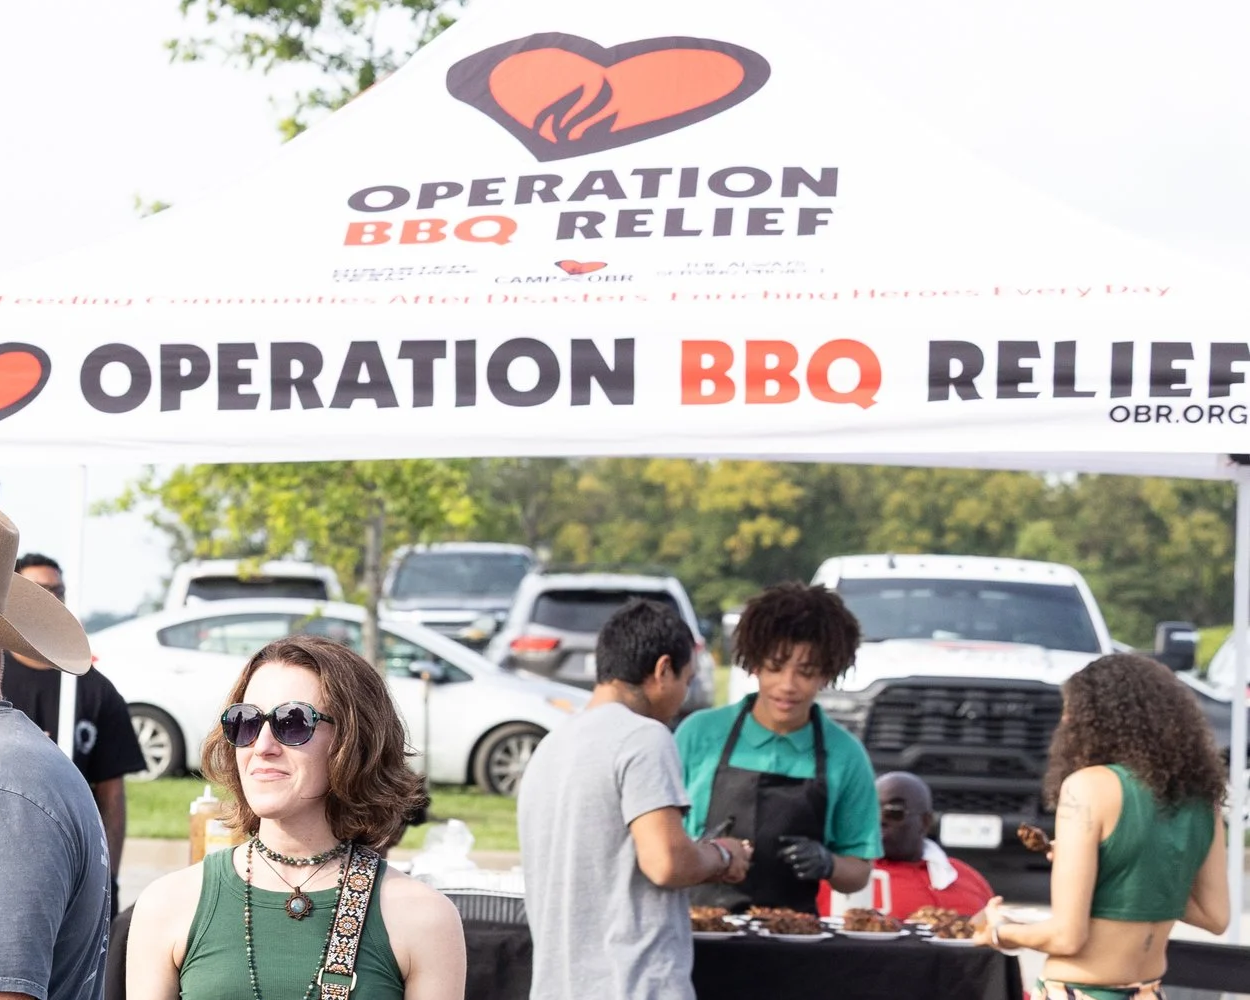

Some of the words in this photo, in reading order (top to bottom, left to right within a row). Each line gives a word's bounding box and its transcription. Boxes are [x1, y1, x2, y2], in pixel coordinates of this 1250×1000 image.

[348, 166, 838, 213] OPERATION
[344, 215, 518, 246] BBQ
[556, 207, 834, 240] RELIEF
[587, 272, 635, 283] OBR
[853, 288, 980, 299] Heroes
[1105, 283, 1172, 297] Day
[79, 337, 636, 414] OPERATION
[680, 338, 883, 409] BBQ
[927, 340, 1250, 402] RELIEF
[1109, 405, 1248, 424] OBR.ORG
